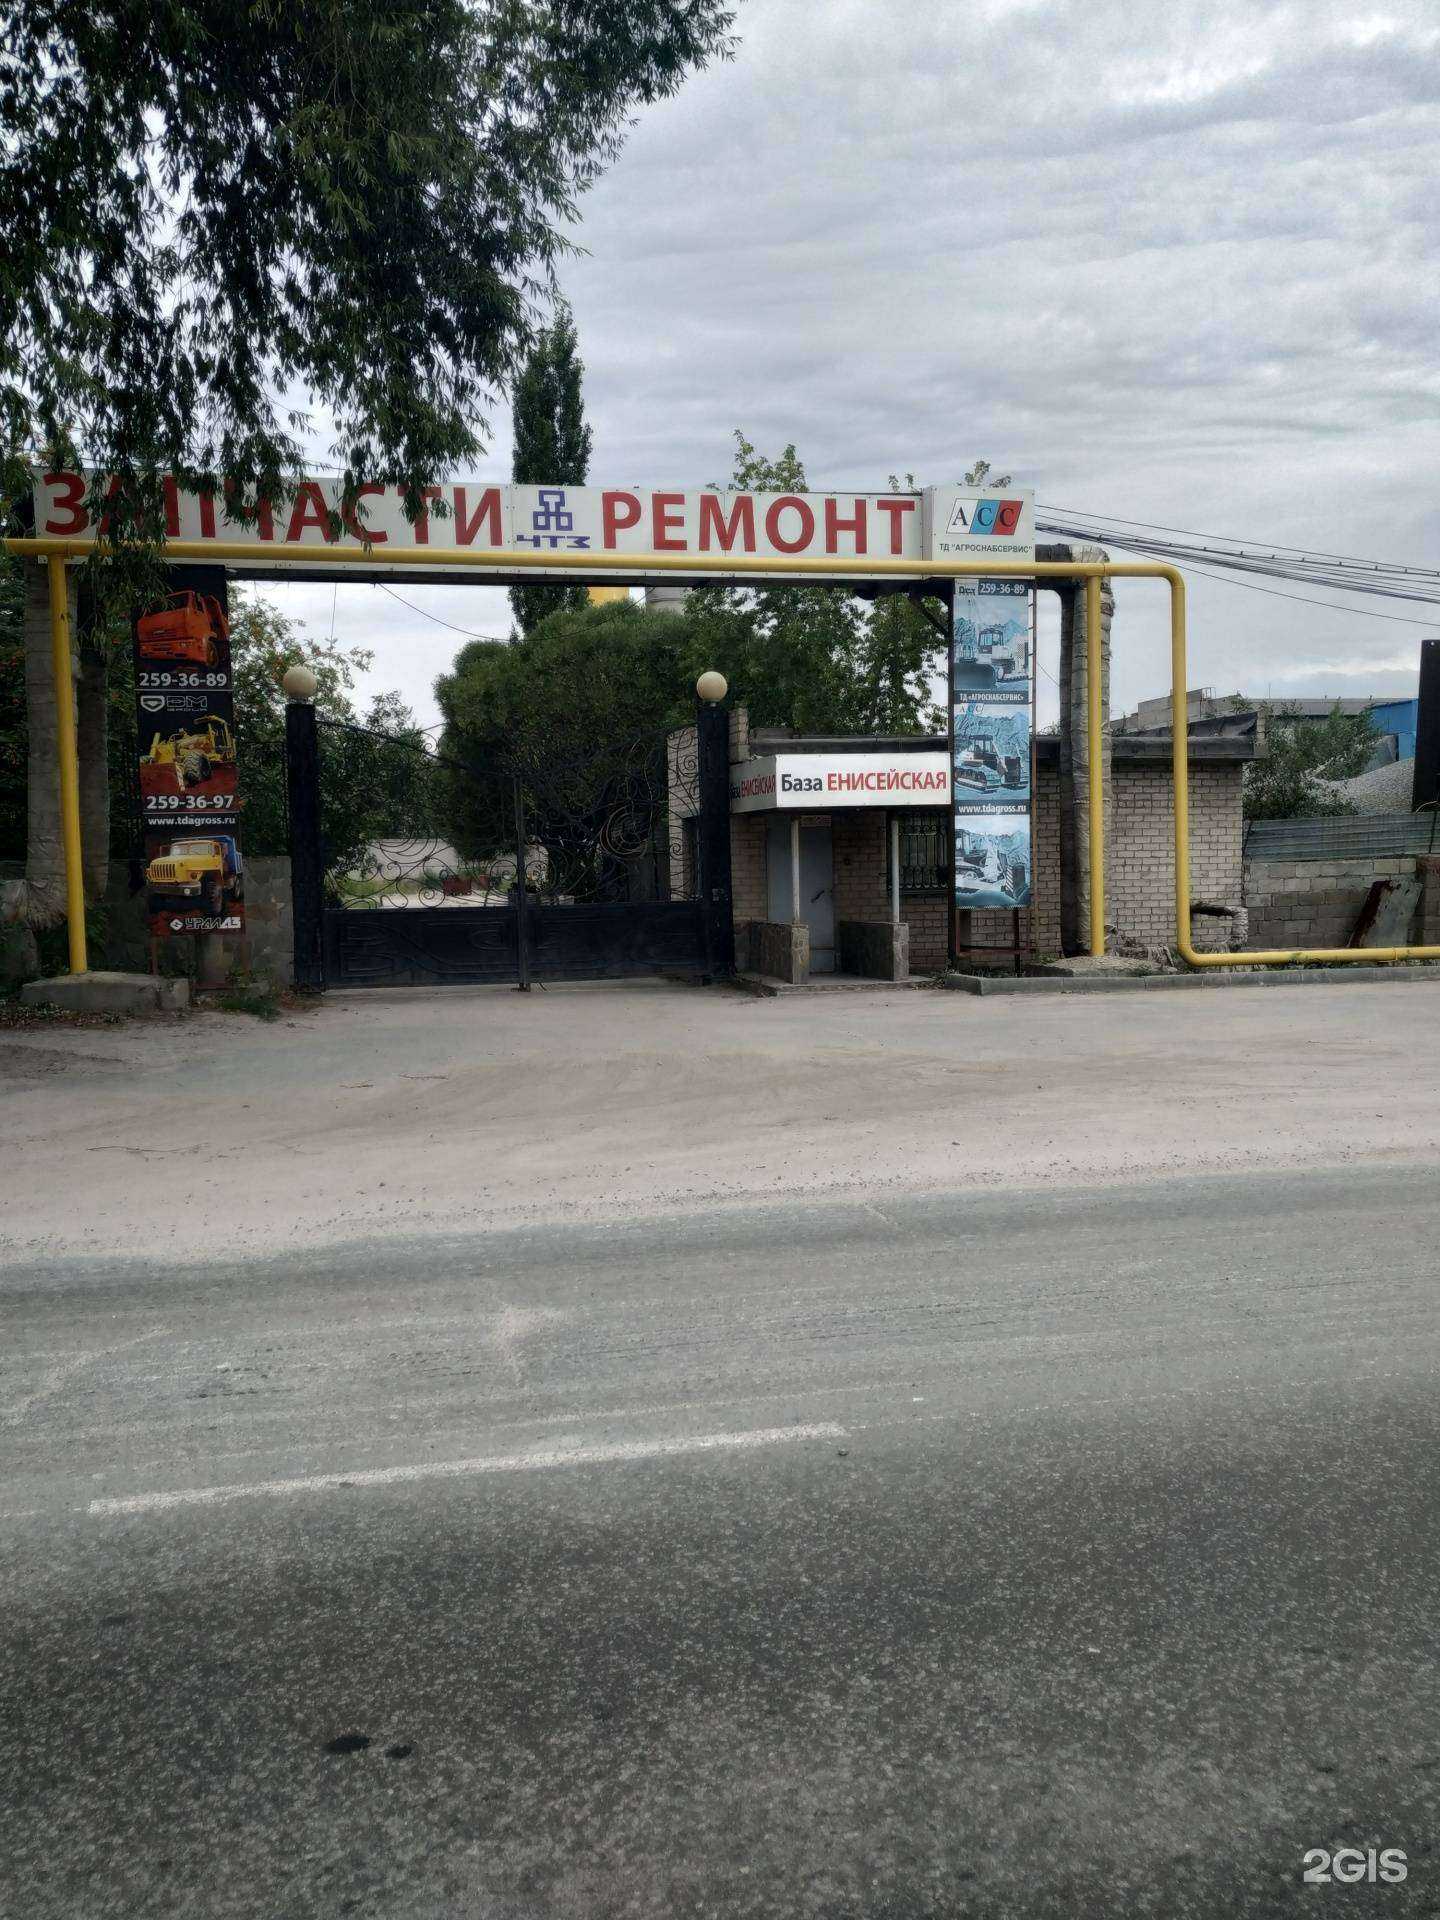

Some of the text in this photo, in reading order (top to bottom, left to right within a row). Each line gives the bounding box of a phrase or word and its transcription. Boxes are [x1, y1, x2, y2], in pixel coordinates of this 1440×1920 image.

[602, 491, 915, 555] РЕМОНТ
[939, 543, 950, 552] ТД
[980, 582, 1025, 595] 259-36-89
[139, 672, 227, 687] 259-36-89
[782, 768, 947, 792] База ЕНИСЕЙСКАЯ
[146, 795, 234, 810] 259-36-97
[958, 805, 1027, 815] www.tdagross.ru
[148, 816, 236, 826] www.tdagross.ru
